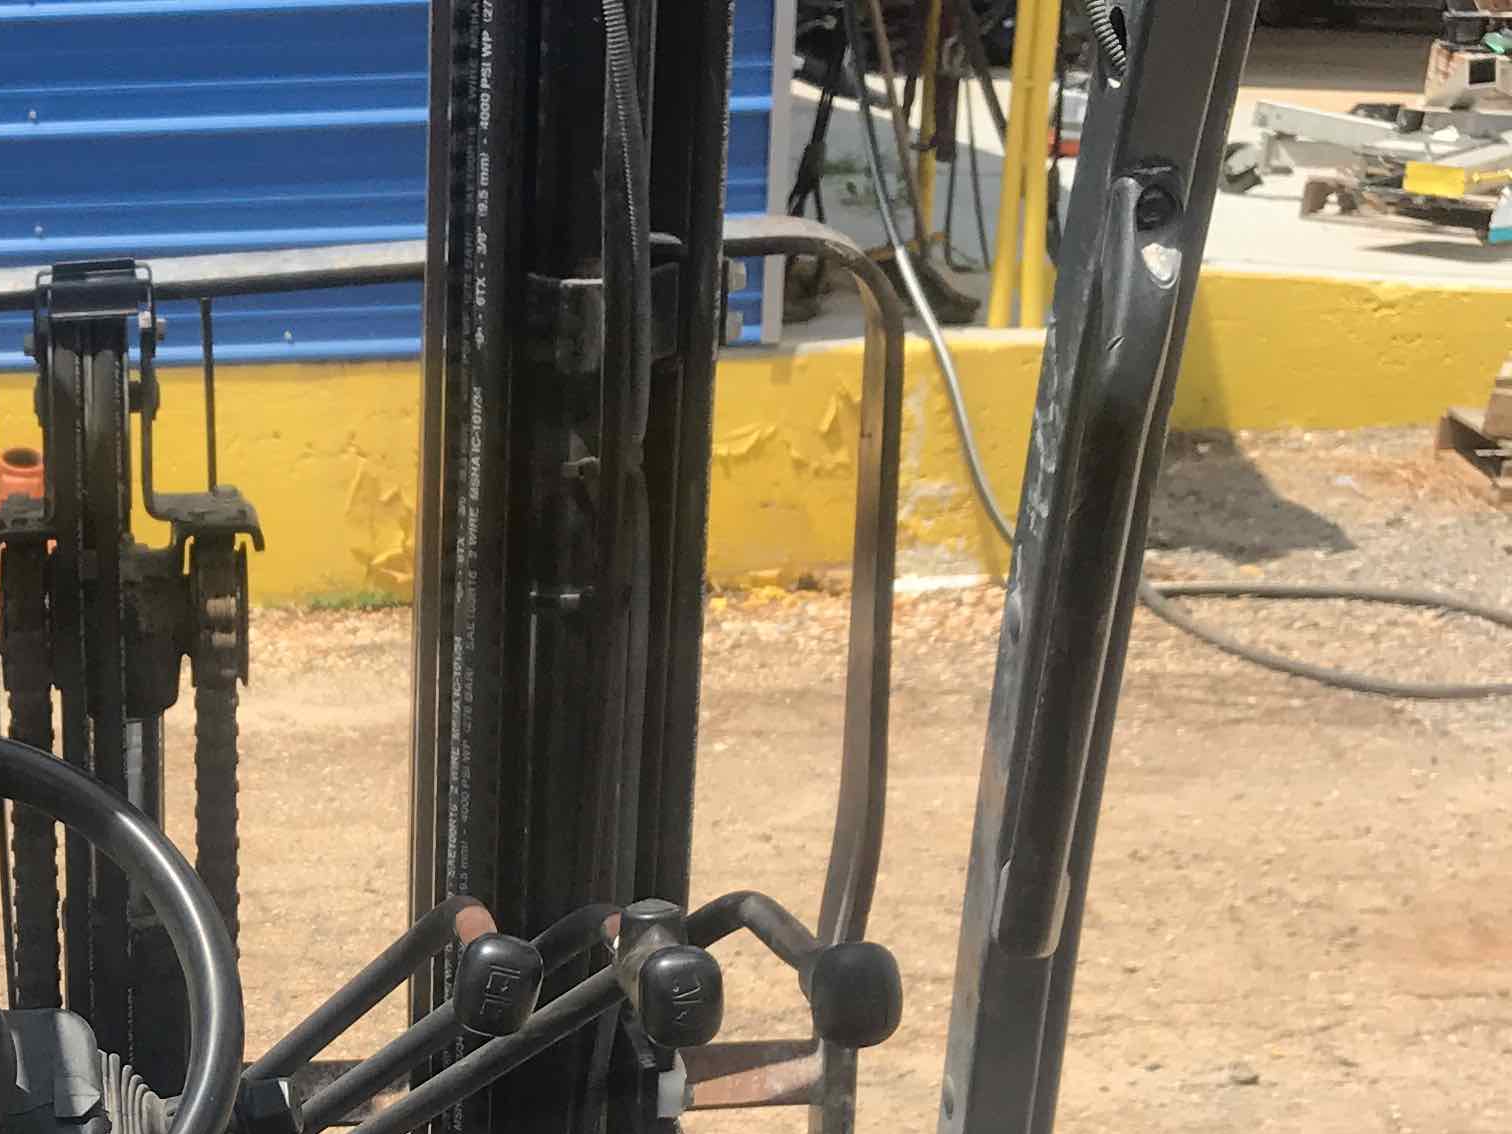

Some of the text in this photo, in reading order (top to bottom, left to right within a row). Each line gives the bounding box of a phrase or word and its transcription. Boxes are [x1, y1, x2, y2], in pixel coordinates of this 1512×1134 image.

[480, 30, 494, 58] WP
[479, 62, 492, 89] PSI
[468, 456, 481, 501] MSHA
[467, 507, 480, 546] WIRE
